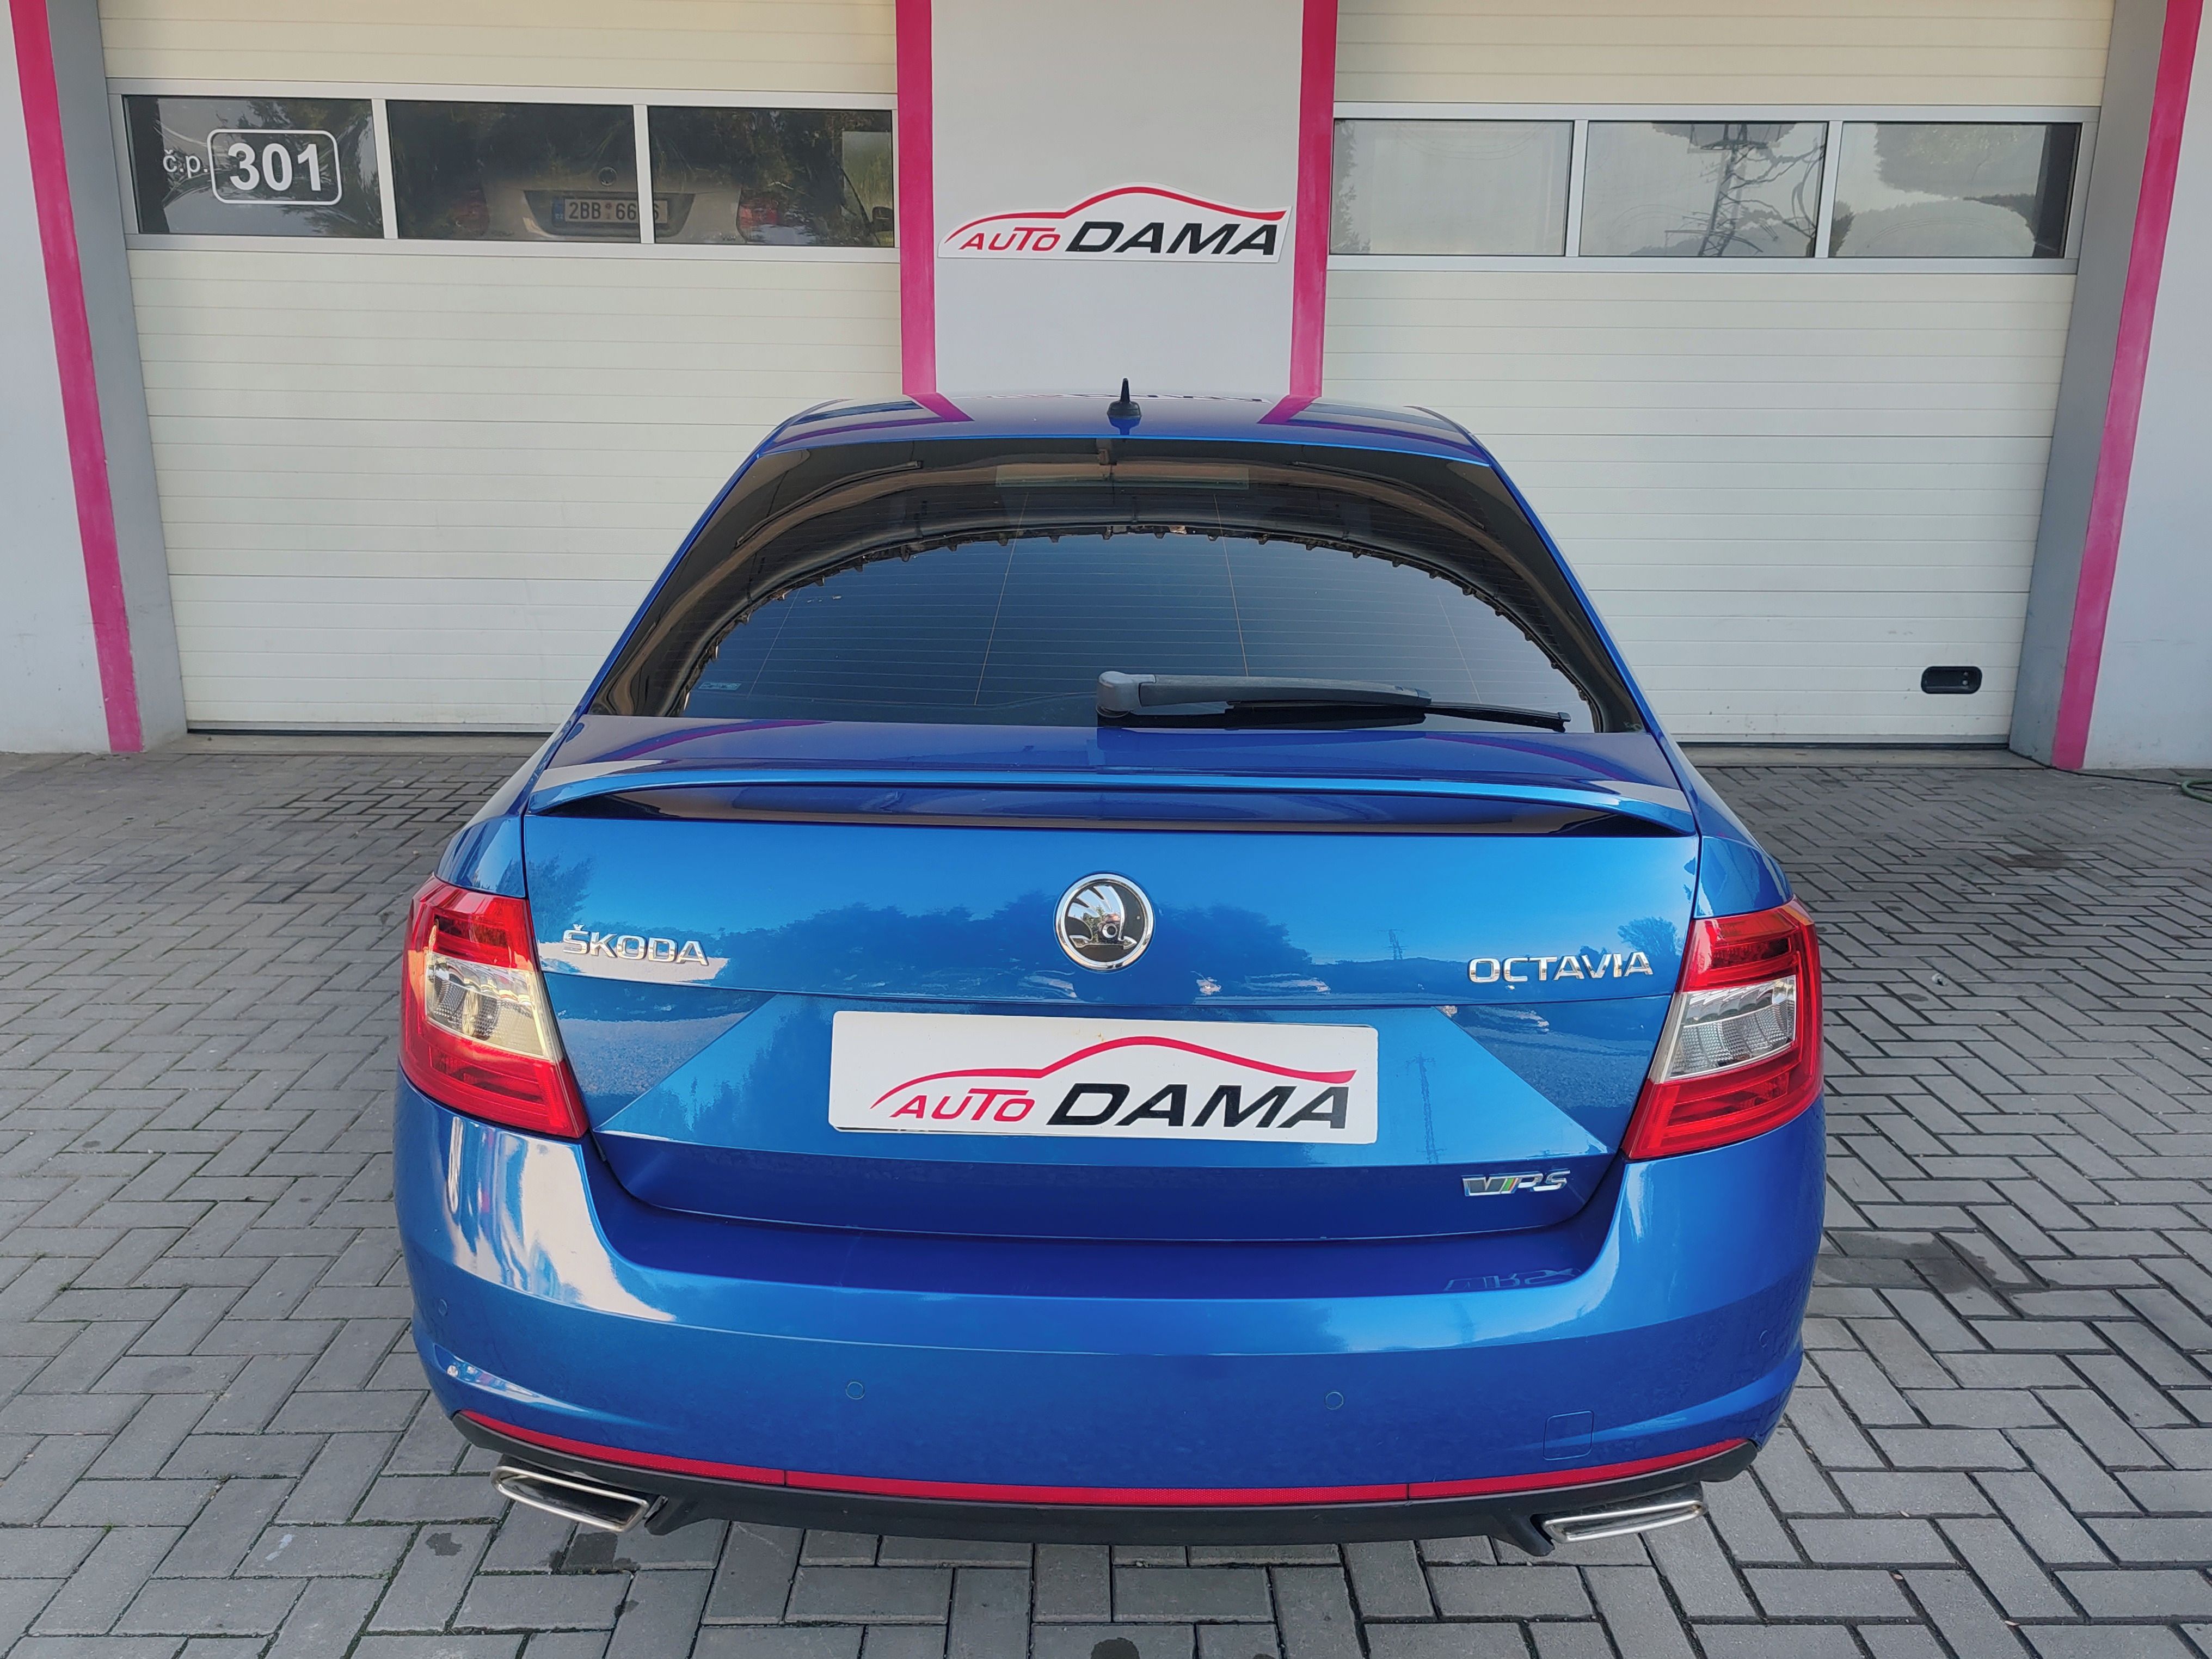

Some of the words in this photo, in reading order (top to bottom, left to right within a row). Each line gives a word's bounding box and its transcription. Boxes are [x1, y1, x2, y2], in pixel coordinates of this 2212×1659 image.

[163, 149, 208, 178] č.p.
[228, 143, 321, 192] 301
[569, 201, 601, 219] 2BB
[958, 227, 1061, 251] AUTO
[1065, 221, 1278, 255] DAMA
[562, 923, 709, 966] ŠKODA
[1469, 951, 1654, 983] OCTAVIA
[889, 1088, 1036, 1122] AUTO
[1046, 1083, 1352, 1129] DAMA
